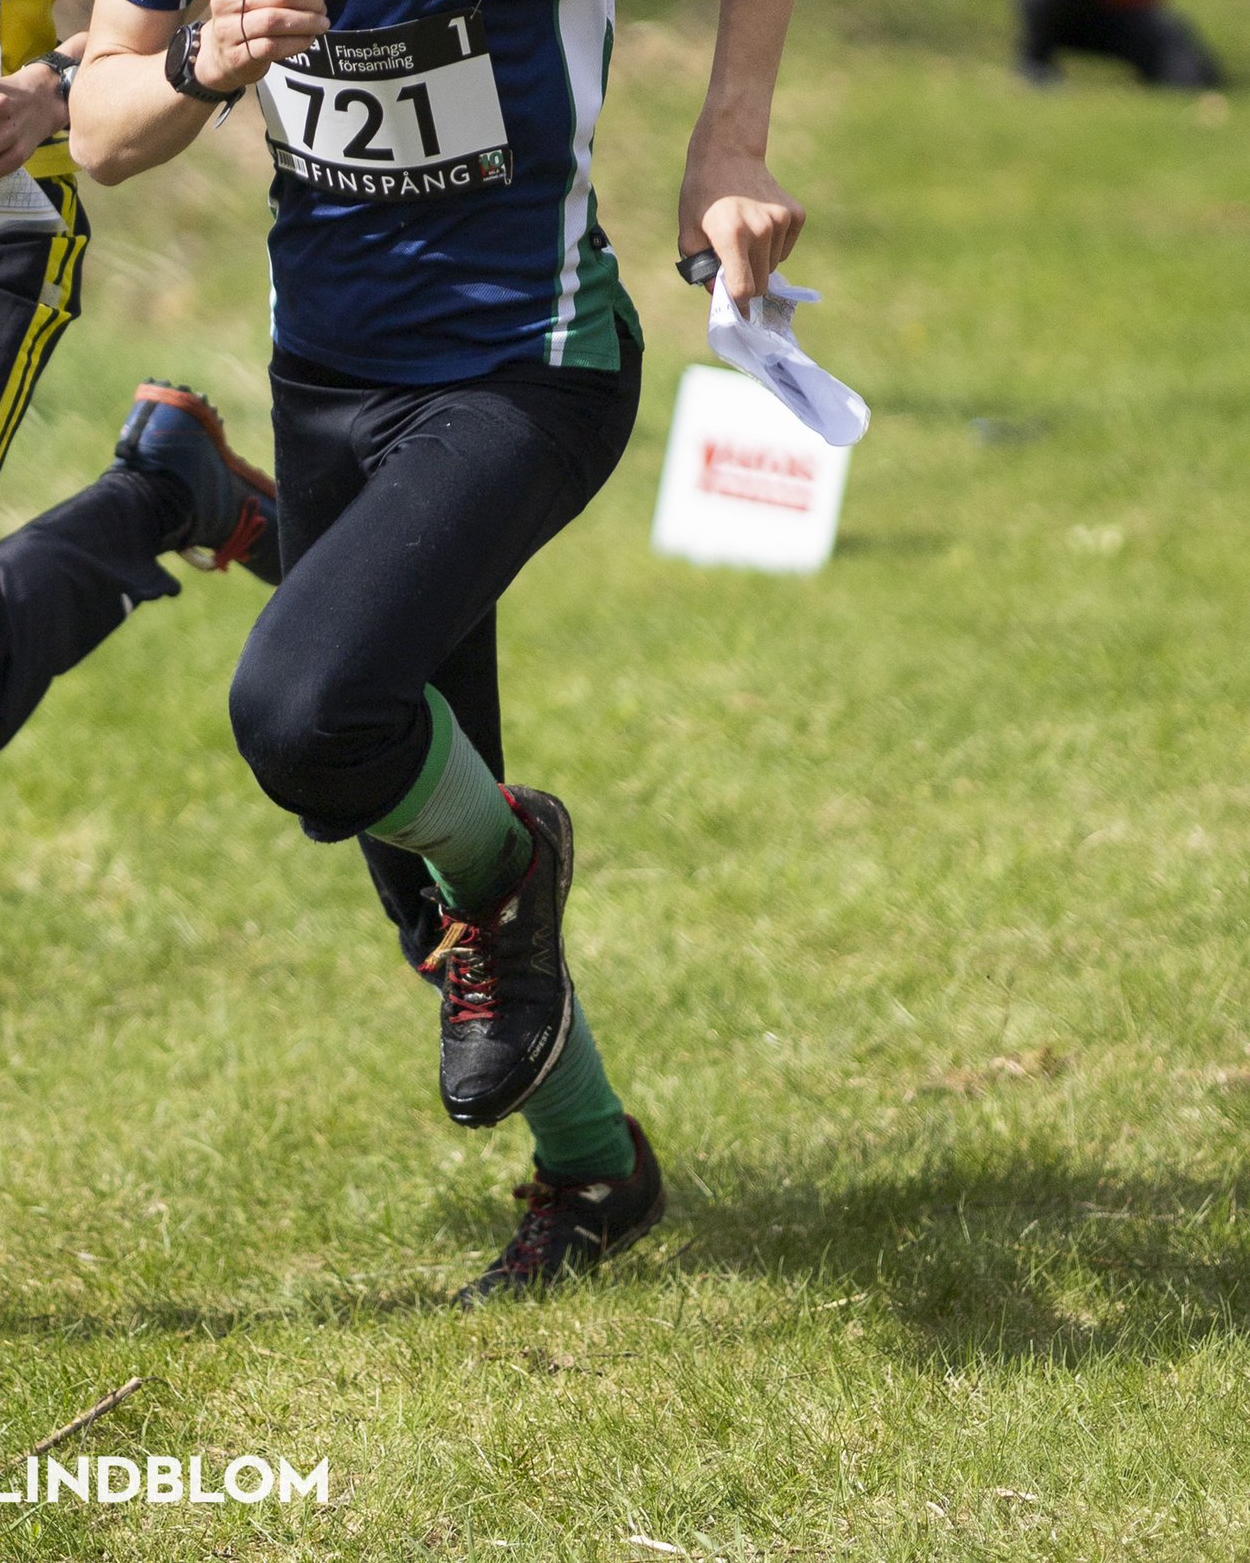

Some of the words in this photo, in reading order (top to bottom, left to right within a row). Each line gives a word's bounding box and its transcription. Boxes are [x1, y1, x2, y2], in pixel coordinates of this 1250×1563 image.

[335, 41, 407, 60] Finspångs
[447, 16, 471, 56] 1
[338, 54, 415, 73] församling
[285, 76, 441, 161] 721
[311, 162, 471, 196] FINSPÅNG
